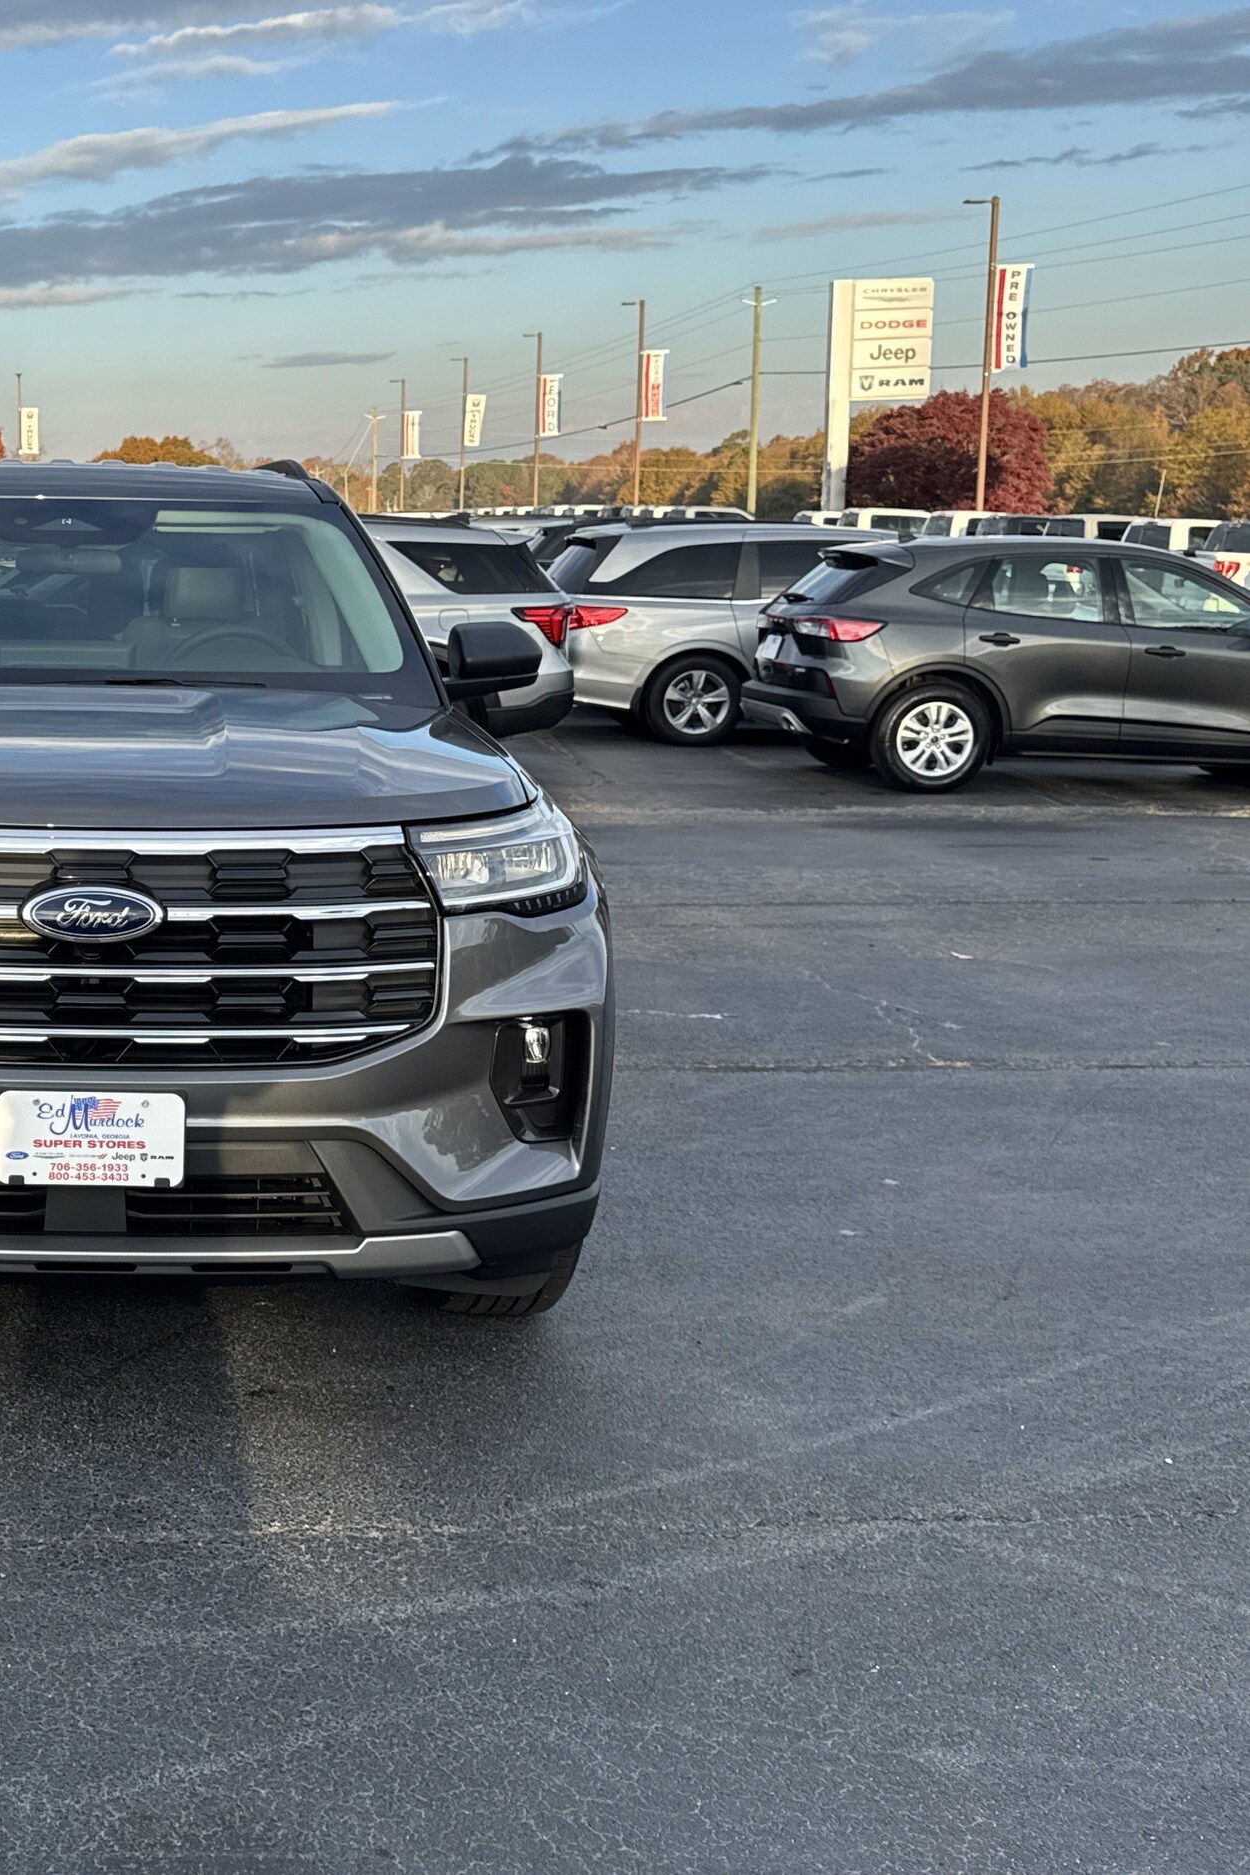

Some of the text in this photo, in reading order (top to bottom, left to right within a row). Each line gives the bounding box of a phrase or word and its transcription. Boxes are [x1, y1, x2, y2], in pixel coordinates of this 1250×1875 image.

[1005, 270, 1021, 364] PRE OWNED
[860, 319, 928, 330] DODGE
[869, 344, 917, 364] Jeep
[878, 378, 925, 387] RAM
[547, 385, 556, 432] FORD
[56, 898, 130, 928] Ford
[36, 1094, 145, 1136] Ed Murdock
[33, 1139, 146, 1150] SUPER STORES
[112, 1152, 136, 1162] Jeep
[50, 1162, 129, 1172] 706-356-1933
[48, 1172, 130, 1182] 800-453-3433
